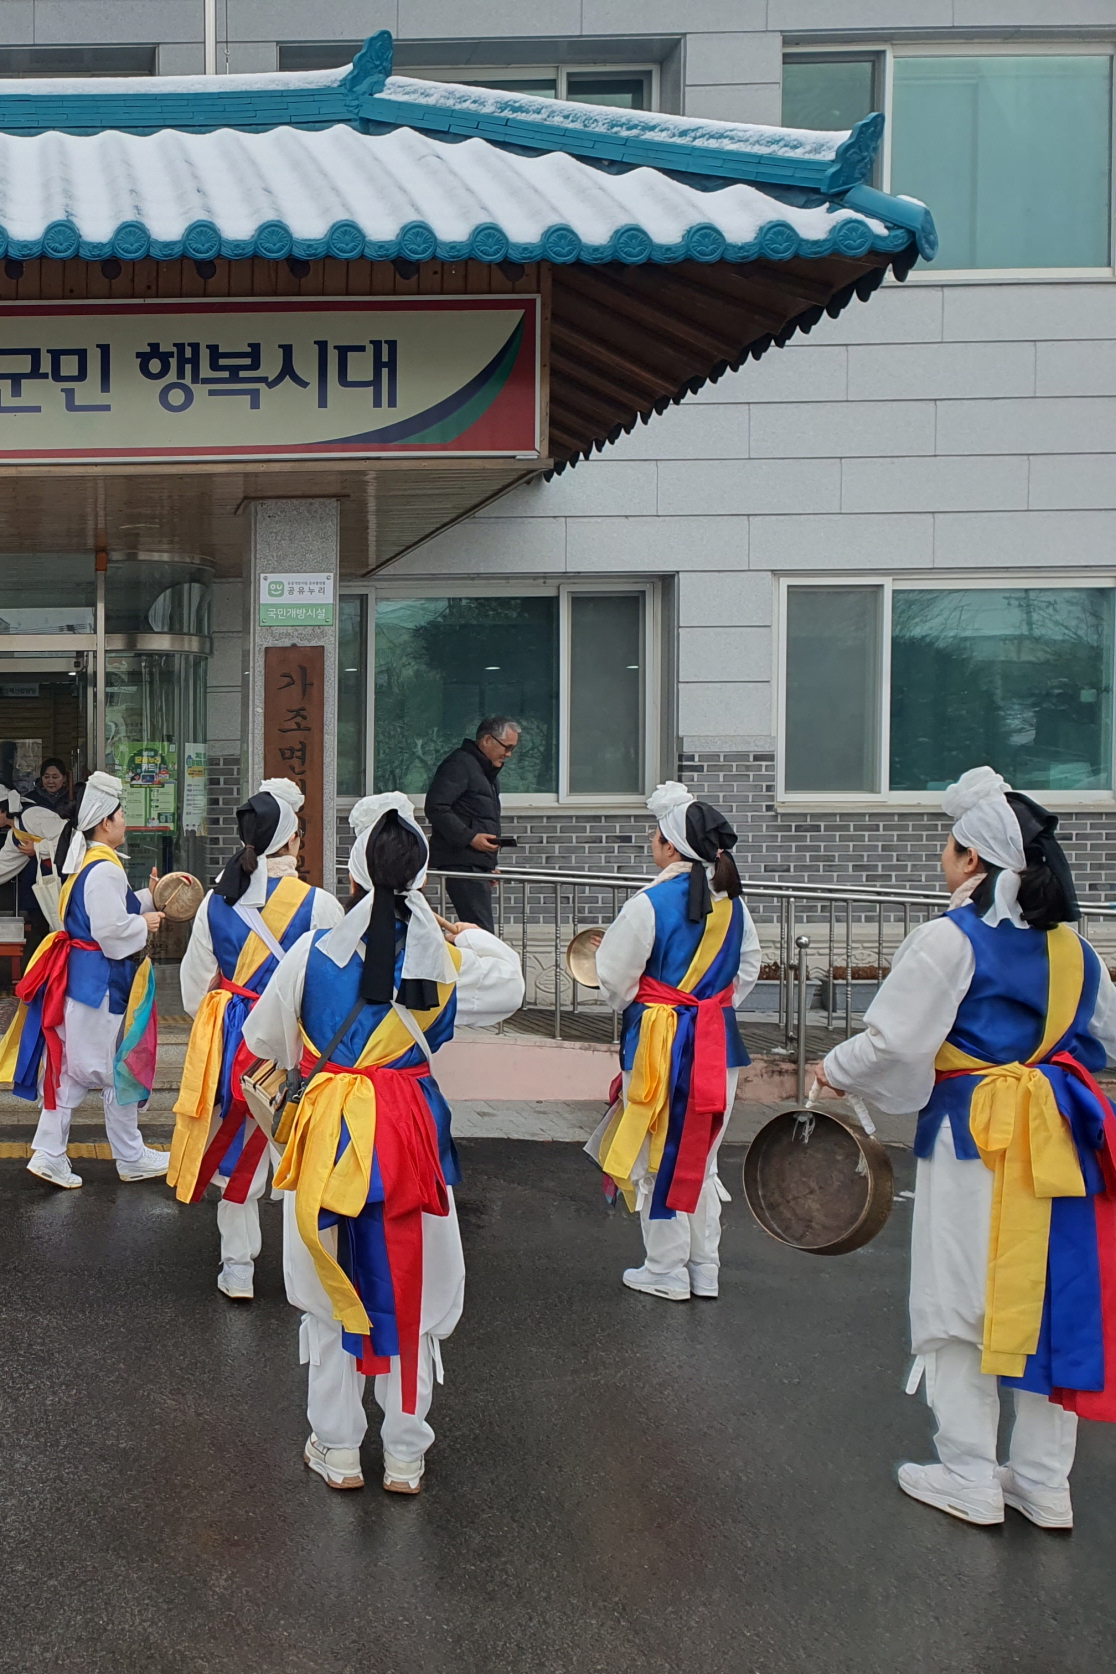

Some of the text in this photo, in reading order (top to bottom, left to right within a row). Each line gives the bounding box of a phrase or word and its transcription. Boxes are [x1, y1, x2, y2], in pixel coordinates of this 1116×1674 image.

[134, 339, 398, 413] 행복시대
[286, 586, 326, 596] 공유누리
[266, 608, 326, 620] 국민개방시설
